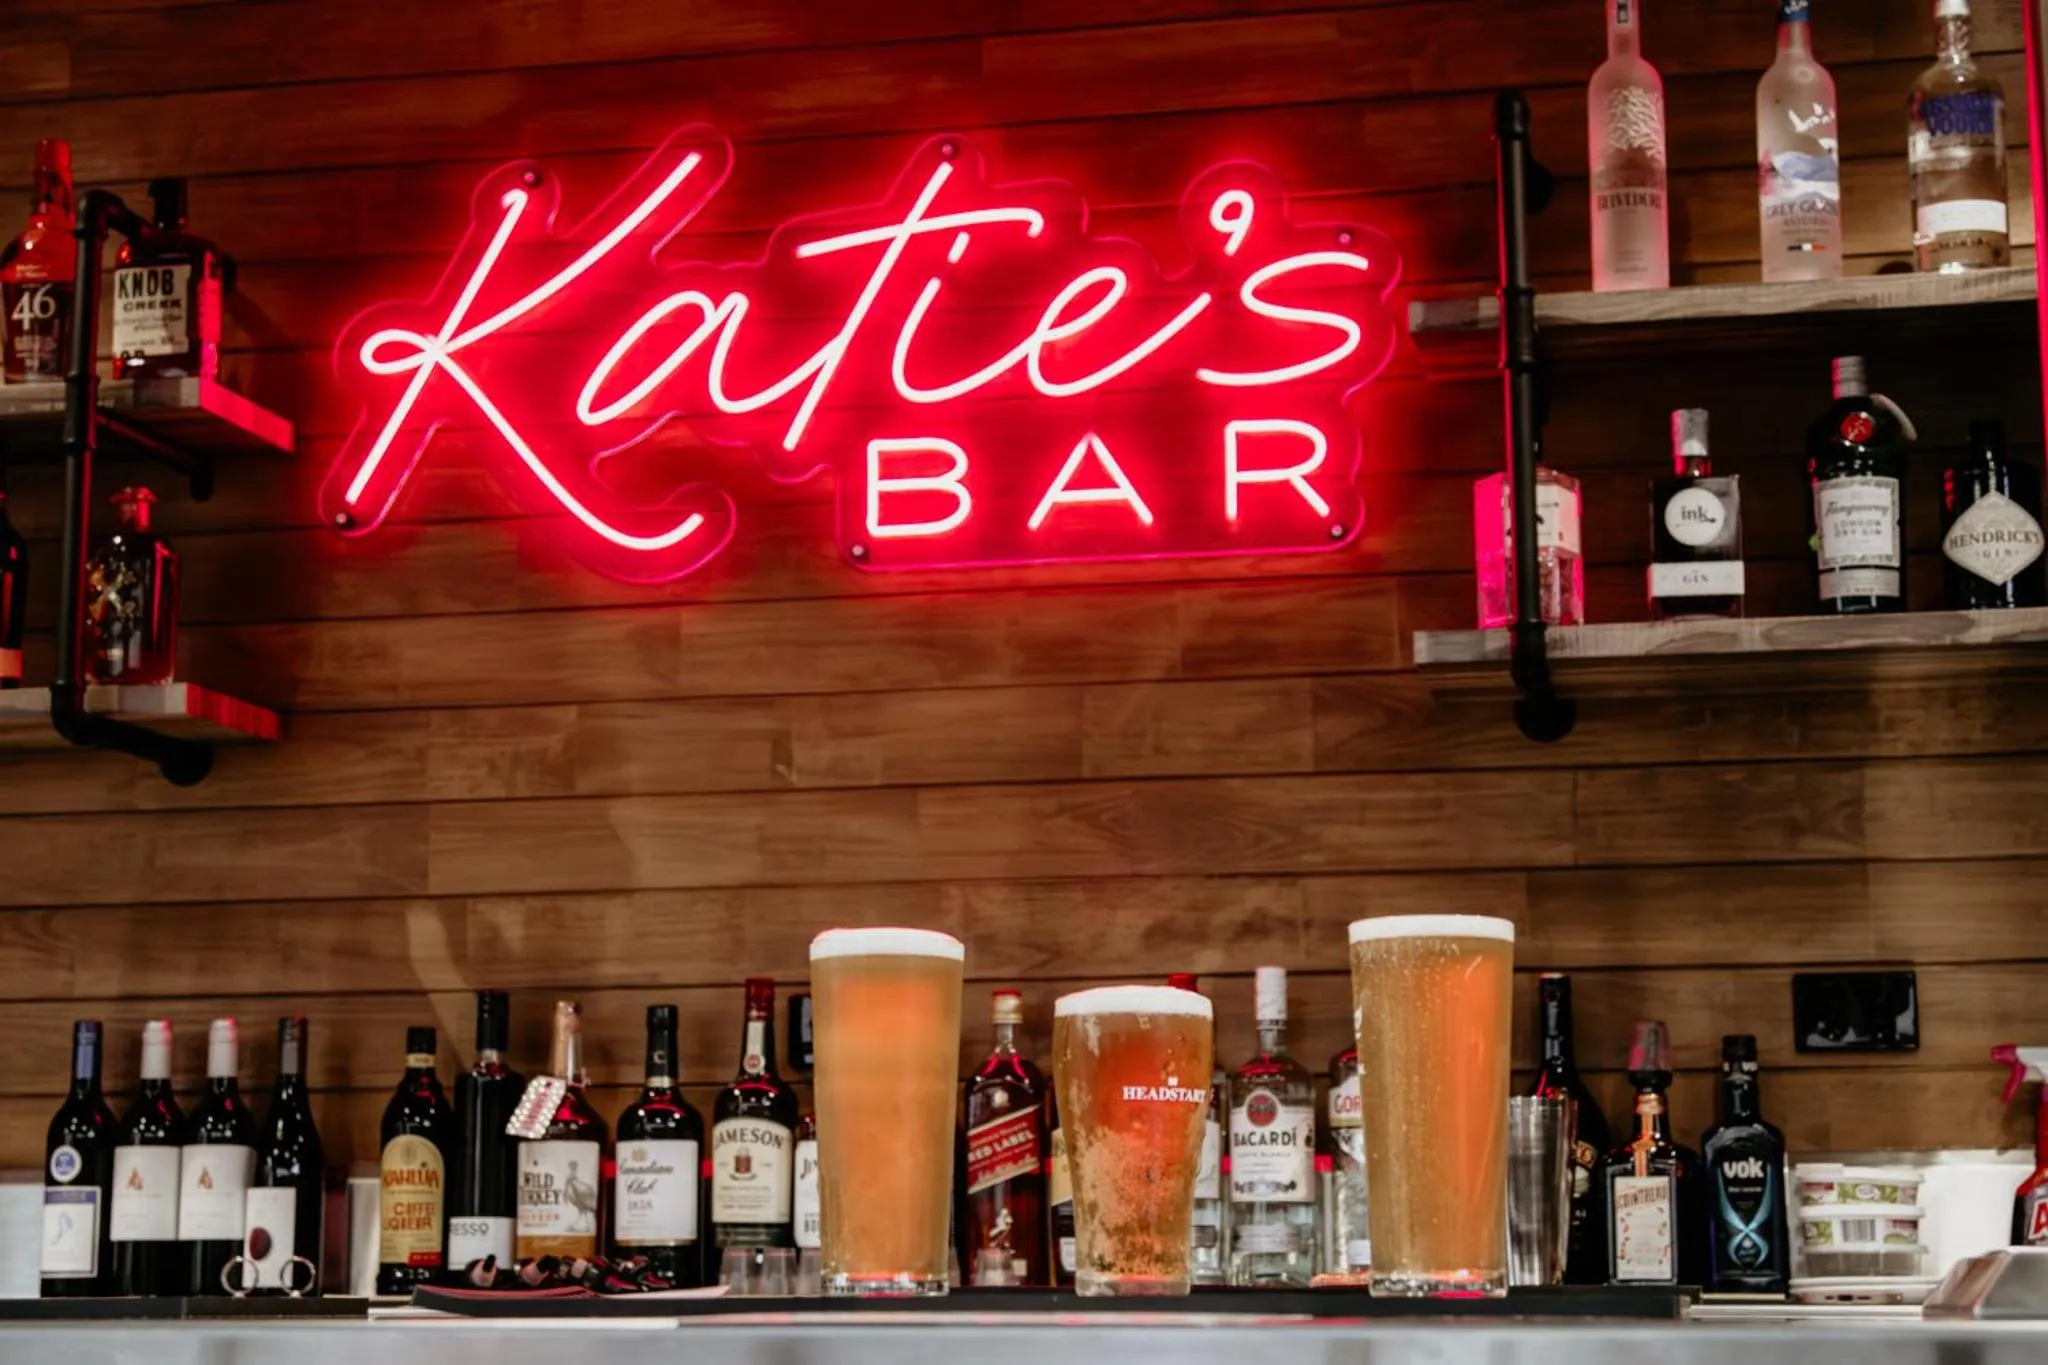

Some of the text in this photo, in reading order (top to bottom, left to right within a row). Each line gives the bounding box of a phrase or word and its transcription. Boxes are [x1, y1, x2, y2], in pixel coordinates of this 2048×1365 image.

[118, 269, 174, 299] KNOB
[11, 283, 56, 330] 46
[343, 150, 1371, 551] Katie's
[864, 419, 1331, 539] BAR
[1122, 1085, 1206, 1103] HEADSTART
[715, 1127, 784, 1150] JAMESON
[968, 1145, 993, 1164] RED
[993, 1130, 1036, 1153] LABEL
[522, 1171, 554, 1189] WILD
[1722, 1156, 1764, 1178] vok
